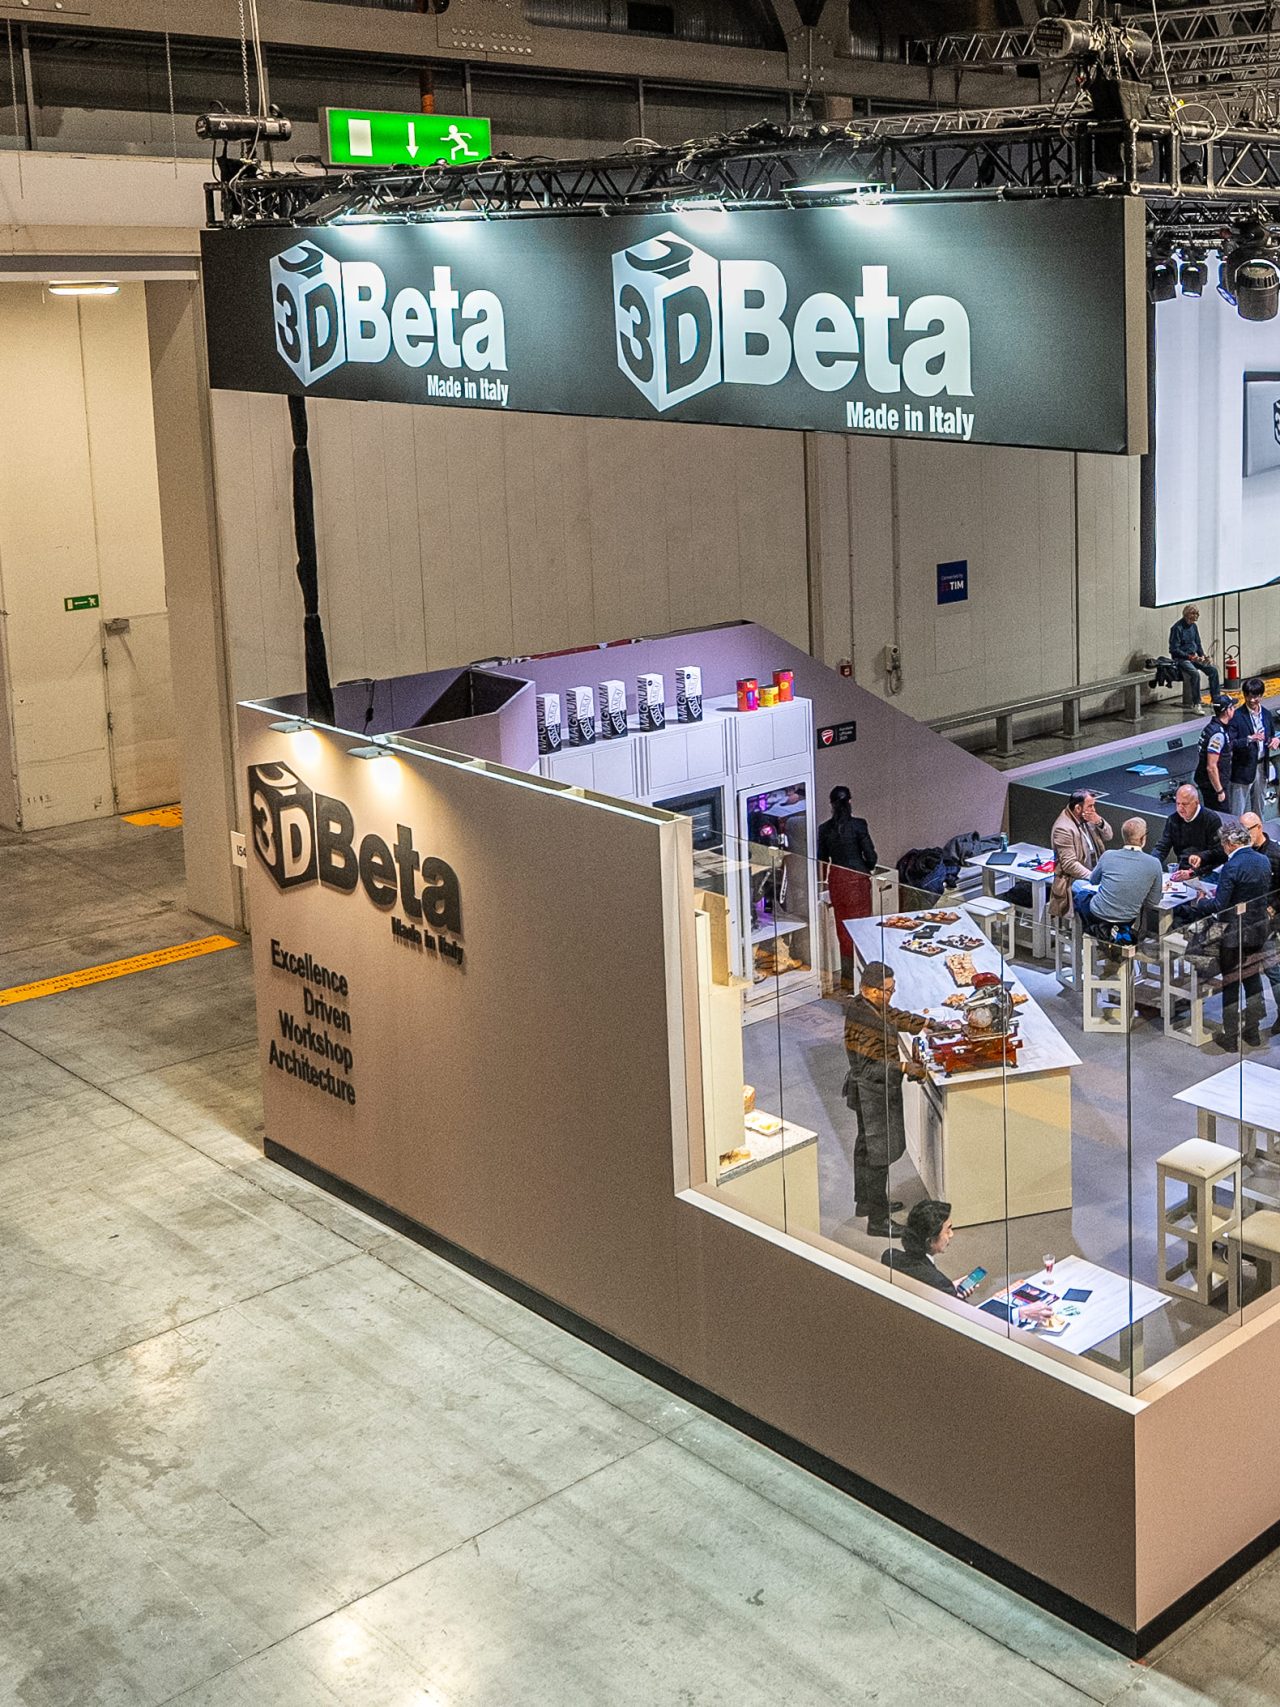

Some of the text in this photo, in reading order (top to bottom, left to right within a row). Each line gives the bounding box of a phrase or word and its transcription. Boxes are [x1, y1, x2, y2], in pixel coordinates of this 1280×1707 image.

[341, 261, 508, 372] Beta
[720, 260, 975, 397] Beta
[427, 375, 509, 406] Made in Italy
[846, 401, 974, 440] Made in Italy
[950, 580, 964, 590] TIM
[316, 793, 462, 935] Beta
[271, 939, 348, 996] Excellence
[391, 916, 464, 965] Made in Italy
[303, 986, 351, 1033] Driven
[279, 1009, 353, 1074] Workshop
[269, 1040, 356, 1105] Architecture
